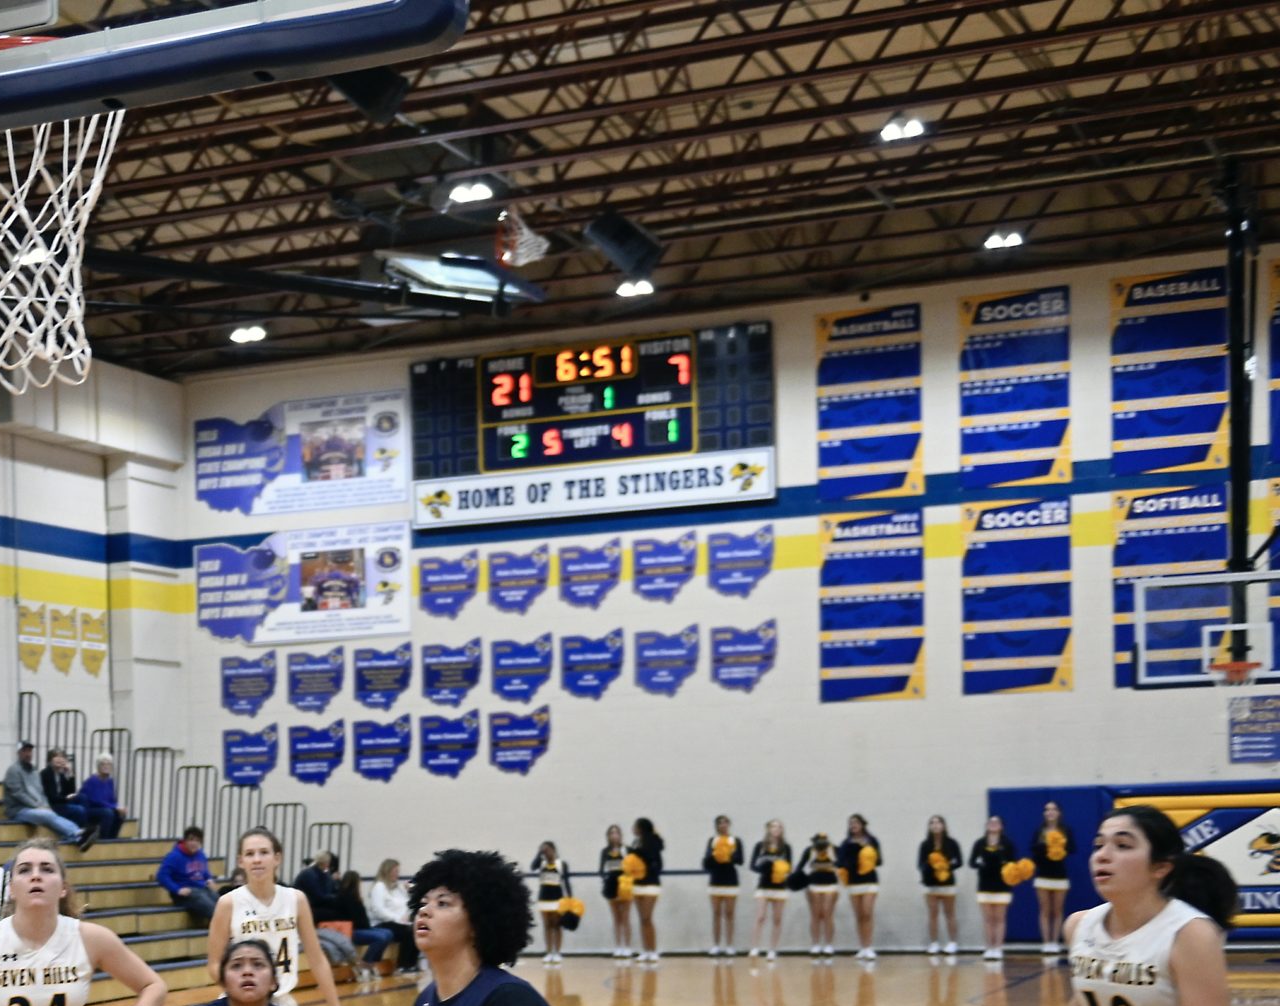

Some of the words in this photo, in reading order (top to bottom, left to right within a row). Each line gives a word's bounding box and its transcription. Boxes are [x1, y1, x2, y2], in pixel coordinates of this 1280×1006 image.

[1132, 278, 1221, 300] BASEBALL
[980, 300, 1066, 322] SOCCER
[832, 318, 915, 336] BASKETBALL
[556, 344, 633, 382] 6:51
[667, 353, 691, 386] 7
[491, 373, 532, 407] 21
[604, 386, 614, 409] 1
[542, 428, 563, 455] 5
[611, 422, 632, 447] 4
[668, 419, 679, 442] 1
[511, 433, 529, 458] 2
[457, 486, 515, 511] HOME
[527, 482, 552, 504] OF
[564, 477, 606, 500] THE
[619, 466, 724, 495] STINGERS
[1133, 493, 1222, 514] SOFTBALL
[982, 507, 1068, 530] SOCCER
[833, 522, 919, 540] BASKETBALL
[42, 966, 79, 985] HILLS
